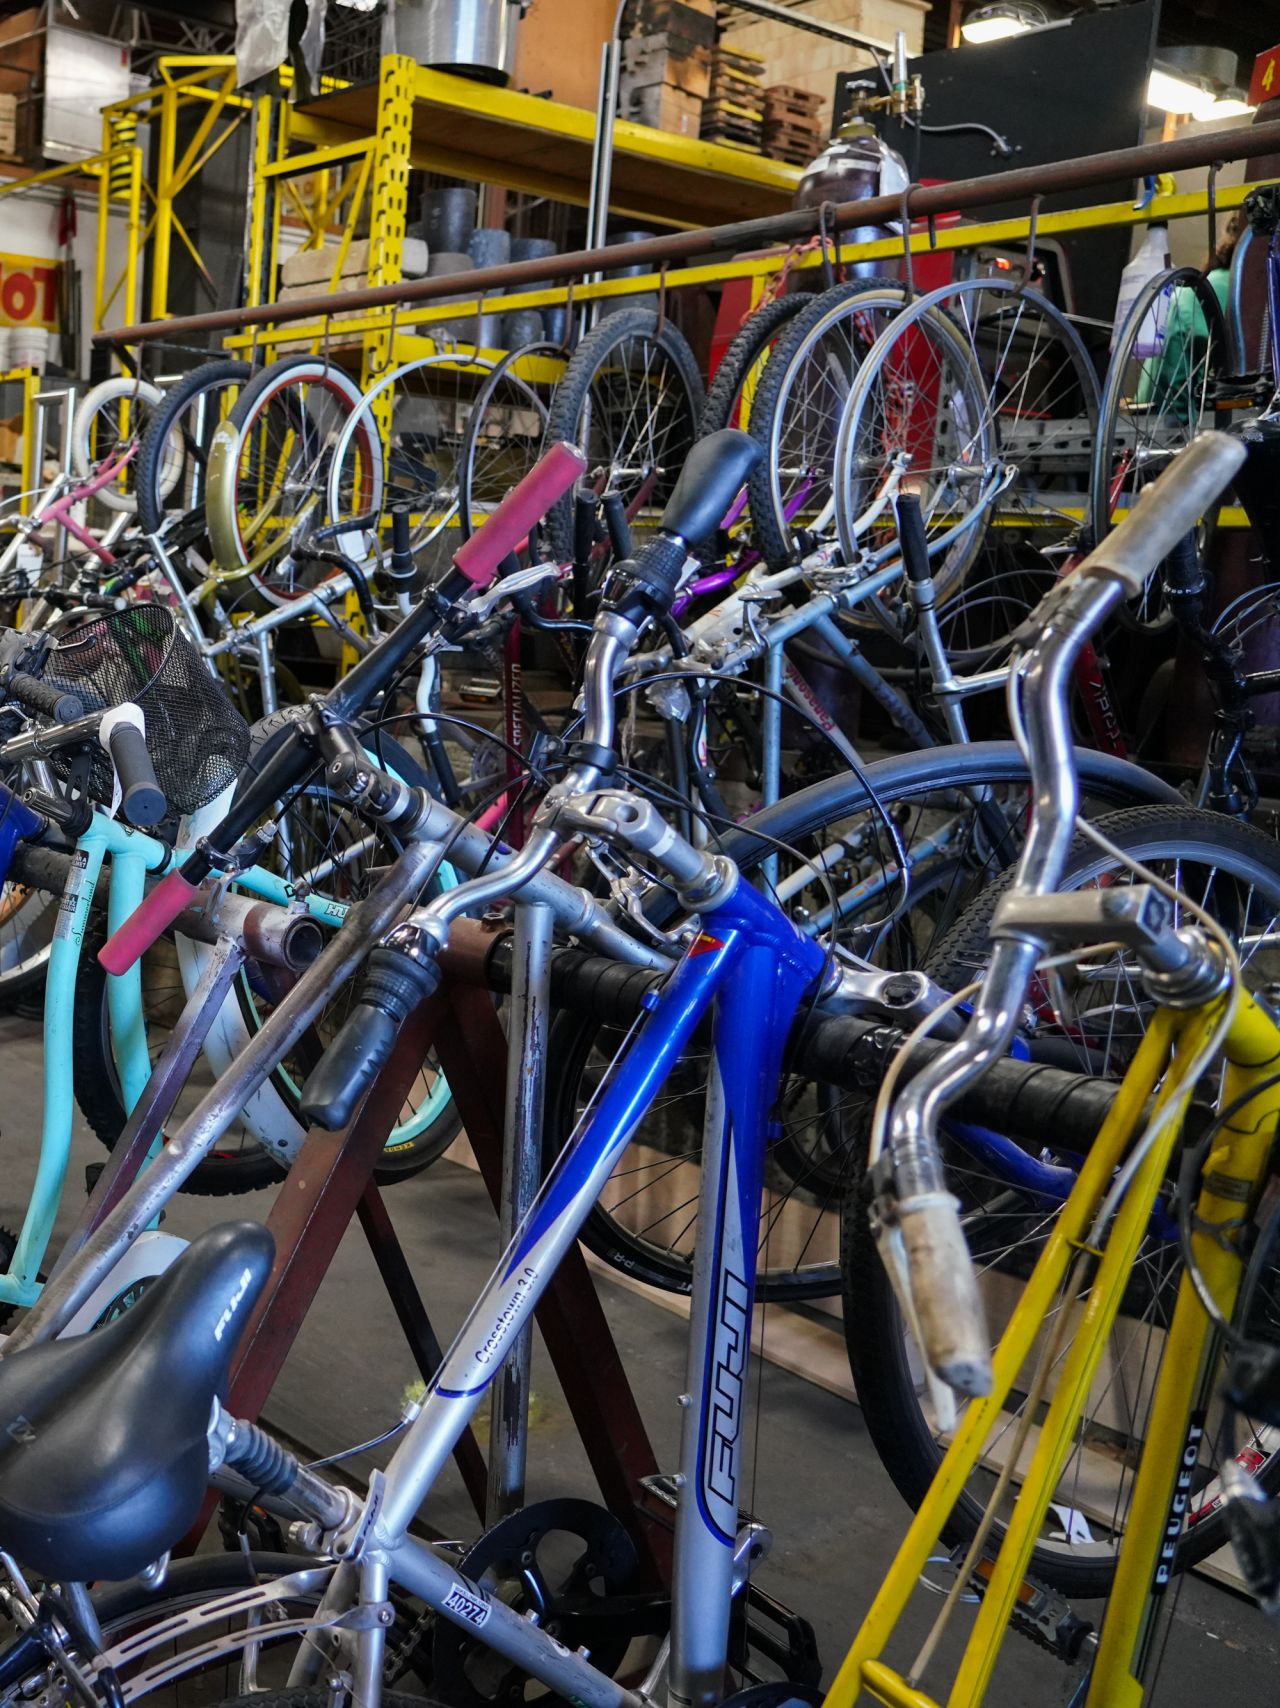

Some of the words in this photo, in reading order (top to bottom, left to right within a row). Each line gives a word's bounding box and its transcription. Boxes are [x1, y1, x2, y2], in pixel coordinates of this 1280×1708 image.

[1261, 58, 1276, 92] 4
[785, 663, 834, 732] Panasonic
[214, 1267, 252, 1342] FUJI
[475, 1291, 527, 1364] Crosstown
[517, 1267, 539, 1291] 3.0
[708, 1267, 751, 1506] FUJI
[1156, 1424, 1203, 1584] PEUGEOT
[446, 1593, 485, 1624] 40274
